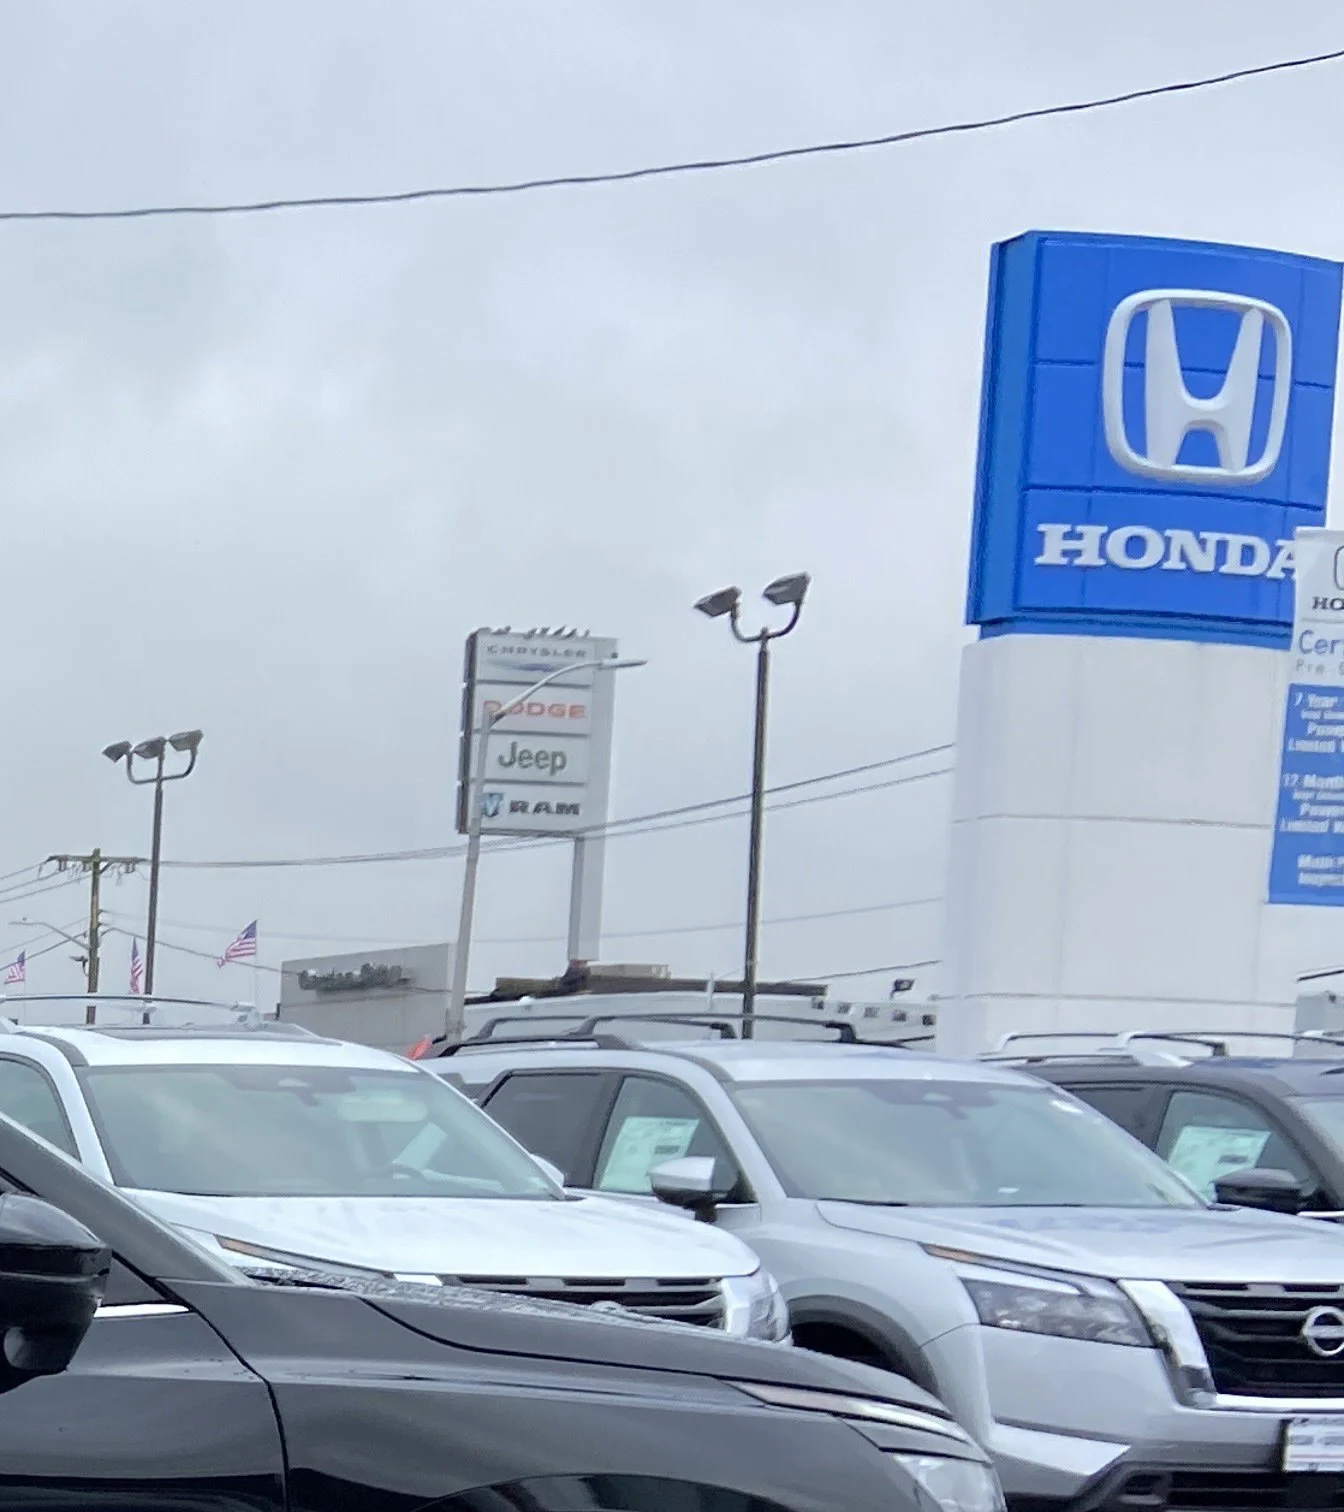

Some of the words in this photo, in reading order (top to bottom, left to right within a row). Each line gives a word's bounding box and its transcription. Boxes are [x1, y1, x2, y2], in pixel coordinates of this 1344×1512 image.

[1034, 523, 1297, 579] HONDA
[497, 740, 568, 776] Jeep
[508, 799, 581, 816] RAM
